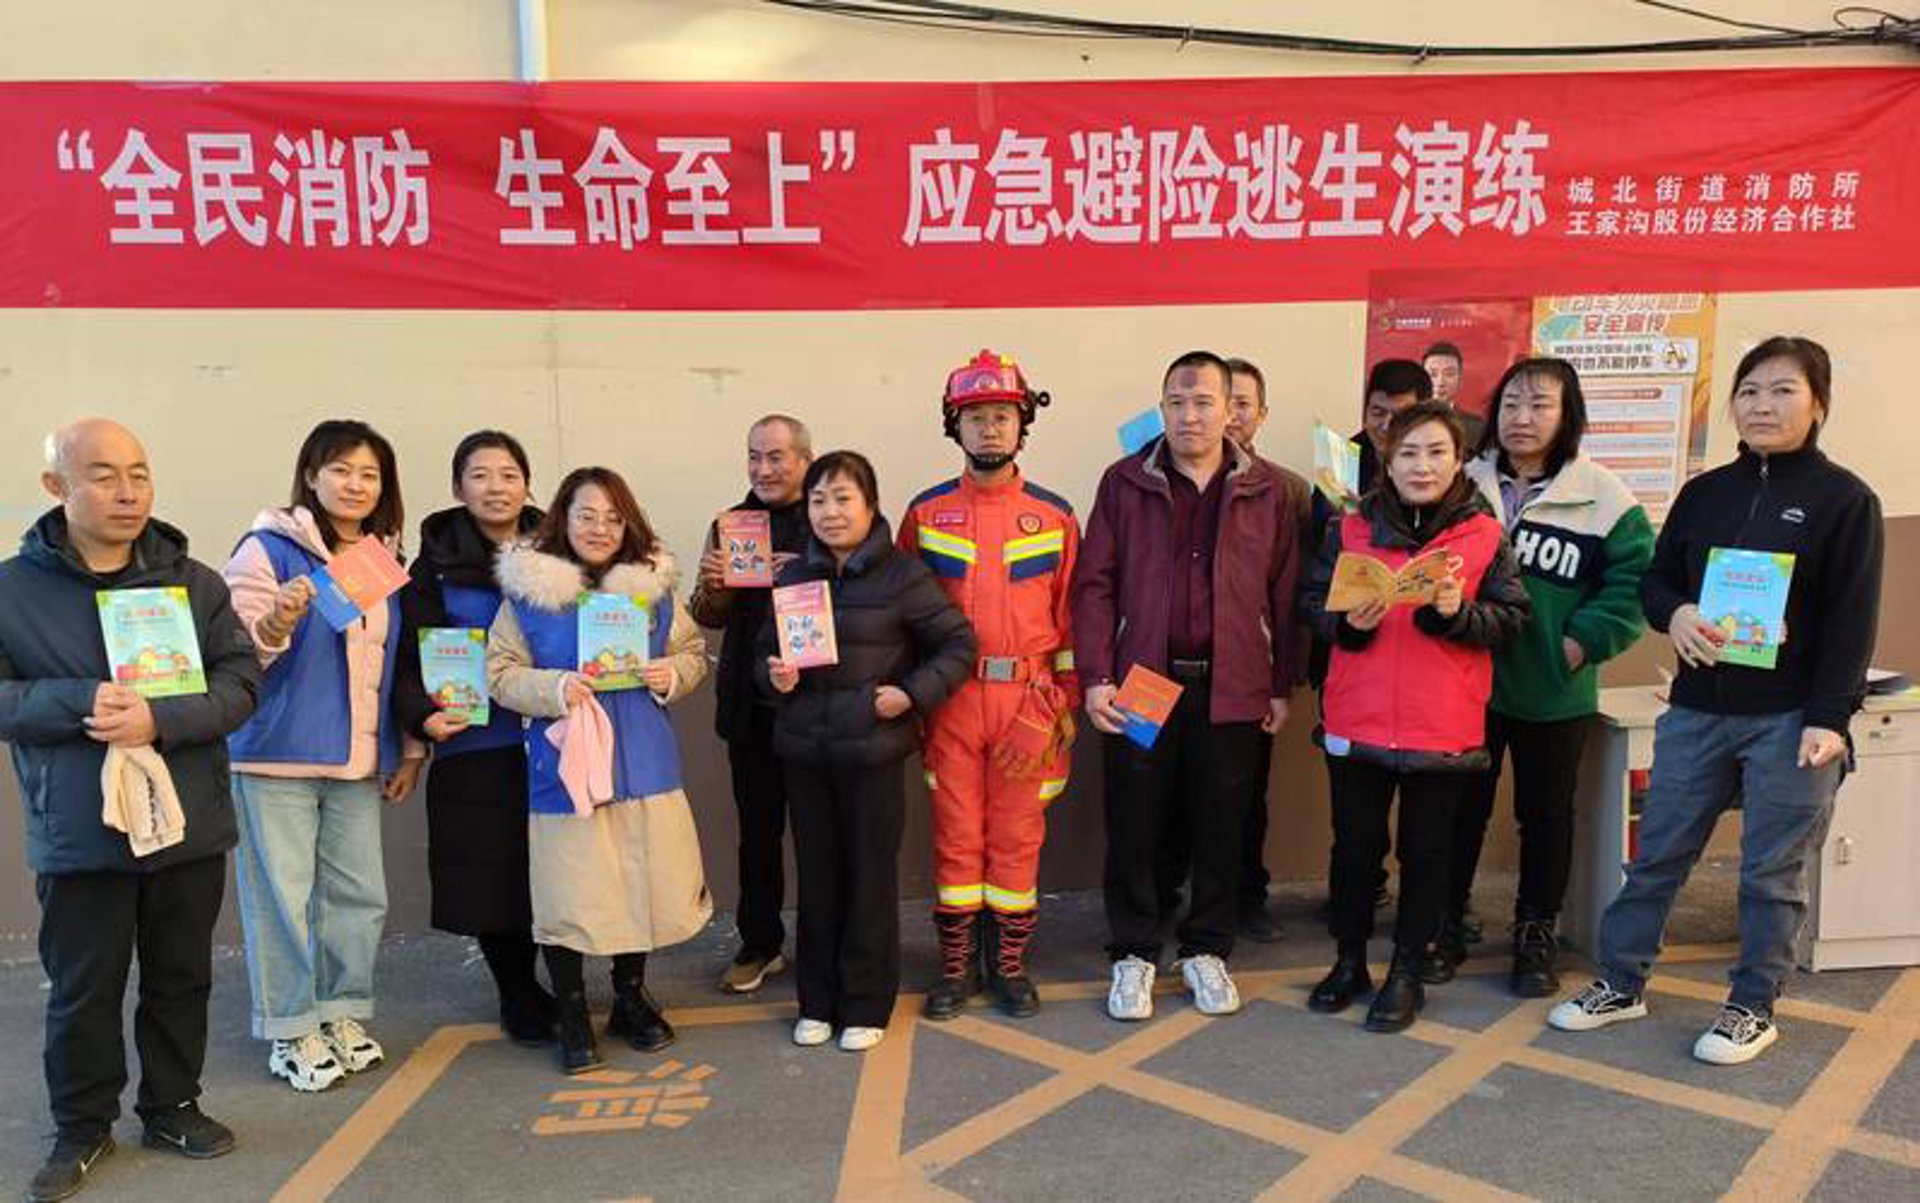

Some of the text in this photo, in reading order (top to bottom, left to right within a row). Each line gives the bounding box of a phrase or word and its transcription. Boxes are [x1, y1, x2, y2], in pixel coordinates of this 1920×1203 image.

[57, 120, 1549, 250] “全民消防 生命至上” 应急避险逃生演练
[1567, 172, 1859, 203] 城北街道消防所
[1566, 204, 1855, 236] 王家沟股份经济合作社
